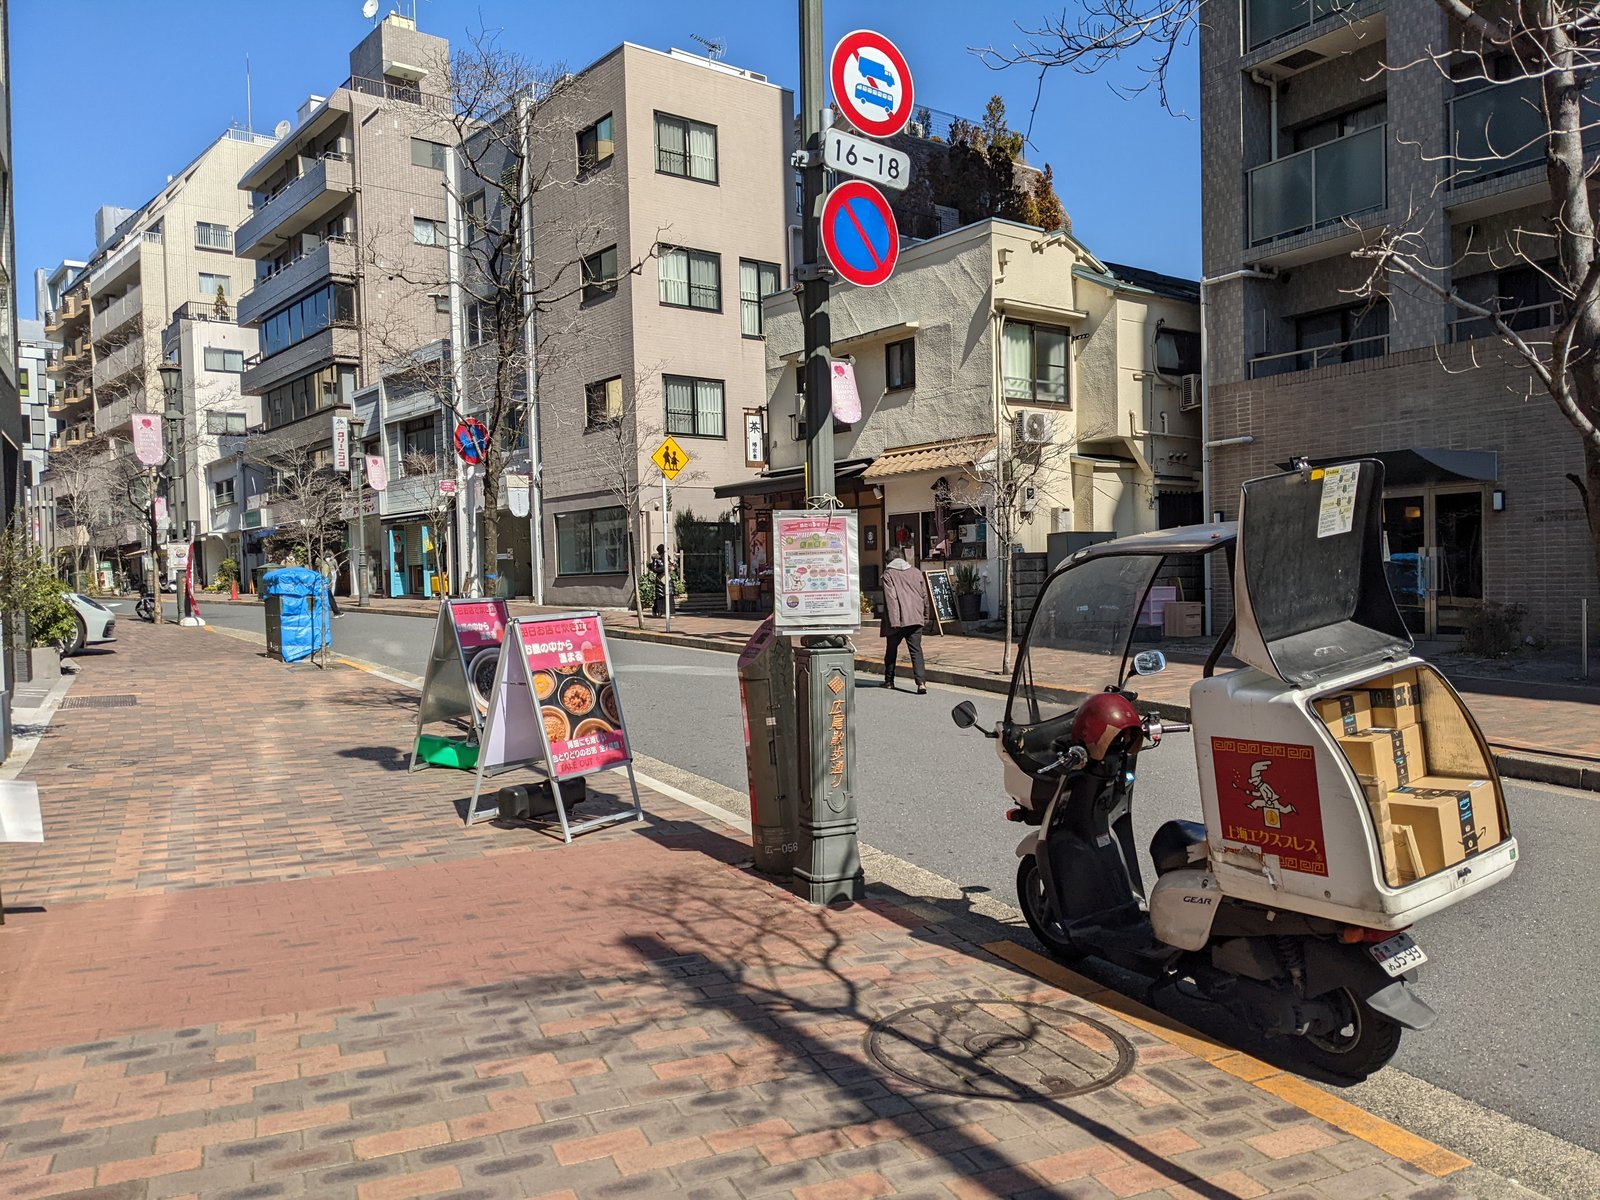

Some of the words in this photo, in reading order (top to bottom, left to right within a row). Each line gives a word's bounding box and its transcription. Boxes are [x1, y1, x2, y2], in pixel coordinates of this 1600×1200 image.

[835, 139, 900, 180] 16-18
[750, 420, 760, 434] 茶
[338, 432, 346, 466] クリーニング
[1226, 824, 1318, 853] 上海エクスプレス
[1183, 896, 1212, 905] GEAR
